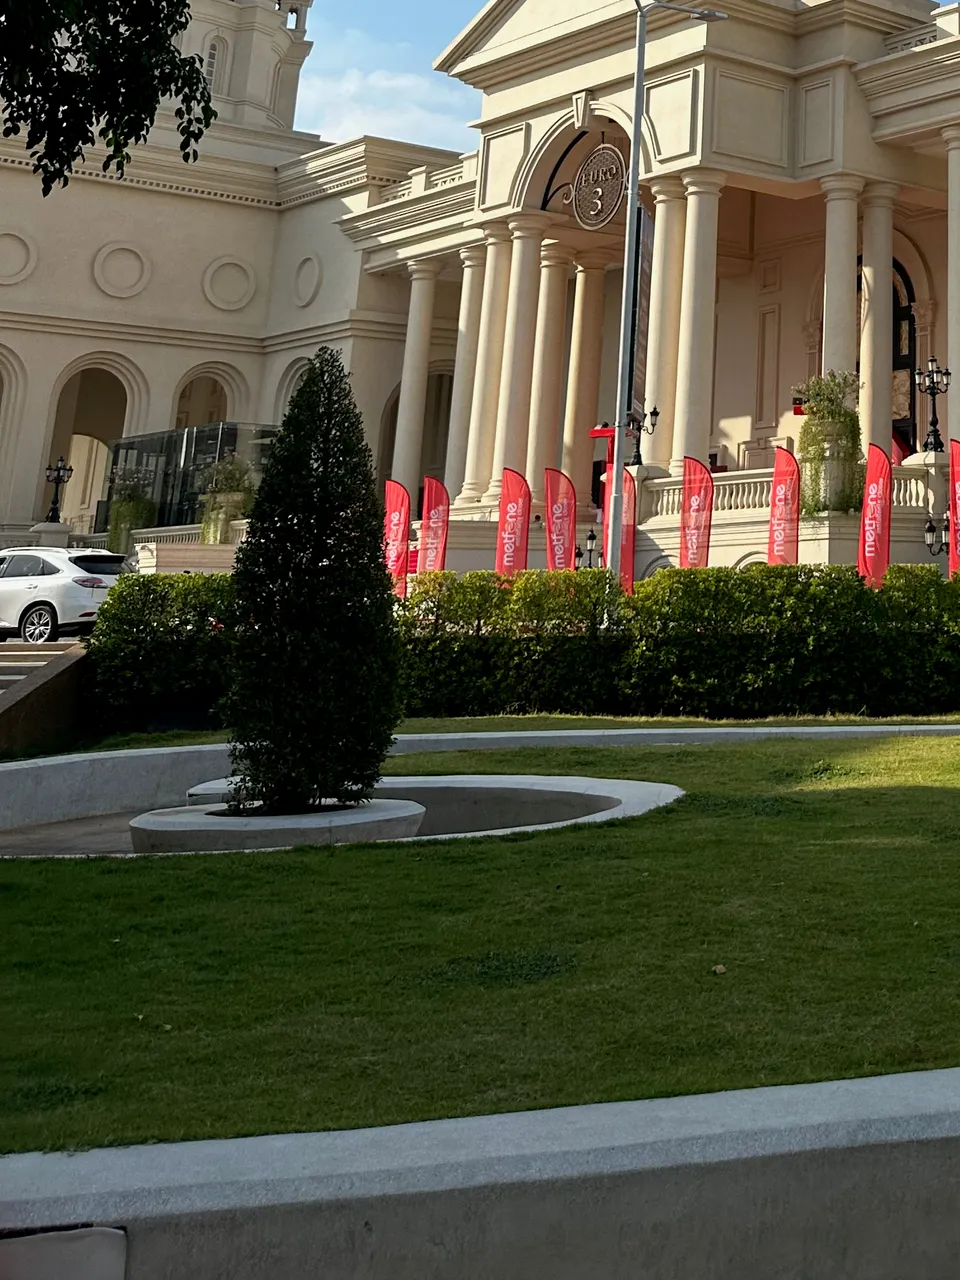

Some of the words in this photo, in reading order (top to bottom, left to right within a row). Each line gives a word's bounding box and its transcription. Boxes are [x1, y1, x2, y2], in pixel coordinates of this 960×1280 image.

[581, 165, 616, 186] EURO
[590, 188, 602, 214] 3
[502, 502, 517, 566] metfone
[551, 503, 565, 568] metfone
[772, 484, 785, 556] metfone
[865, 483, 877, 556] metfone
